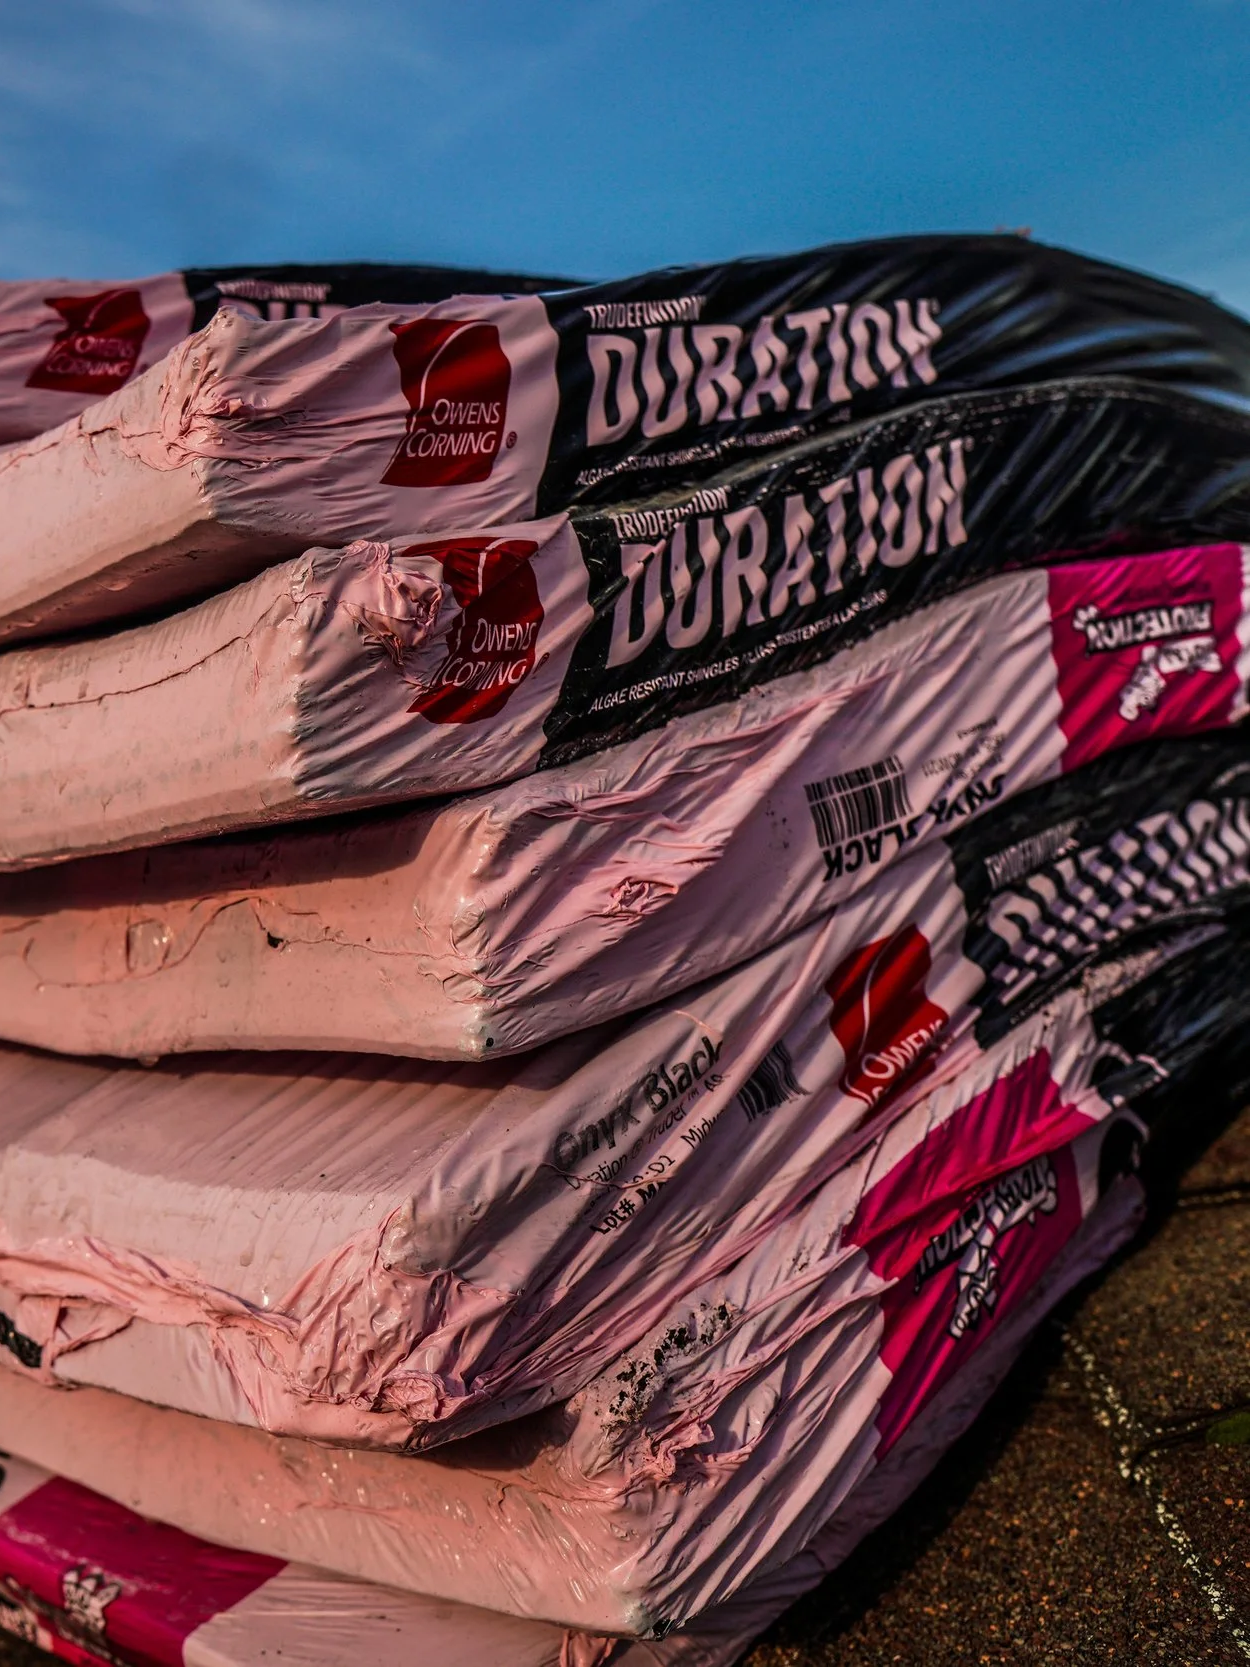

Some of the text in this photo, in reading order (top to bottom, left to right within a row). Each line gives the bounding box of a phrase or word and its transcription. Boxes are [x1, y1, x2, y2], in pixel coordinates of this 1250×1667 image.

[584, 297, 701, 330] TRUDEFINITION
[586, 299, 943, 447] DURATION
[431, 398, 501, 426] OWENS
[405, 427, 497, 458] CORNING
[610, 486, 730, 539] TRUDEFITION
[605, 437, 968, 671] DURATION
[471, 617, 537, 655] OWENS
[587, 692, 628, 715] ALGAE
[684, 655, 740, 686] SHINGLES
[554, 1035, 725, 1172] Onyx Black
[564, 1153, 628, 1190] Dration
[589, 1197, 636, 1235] Lot#
